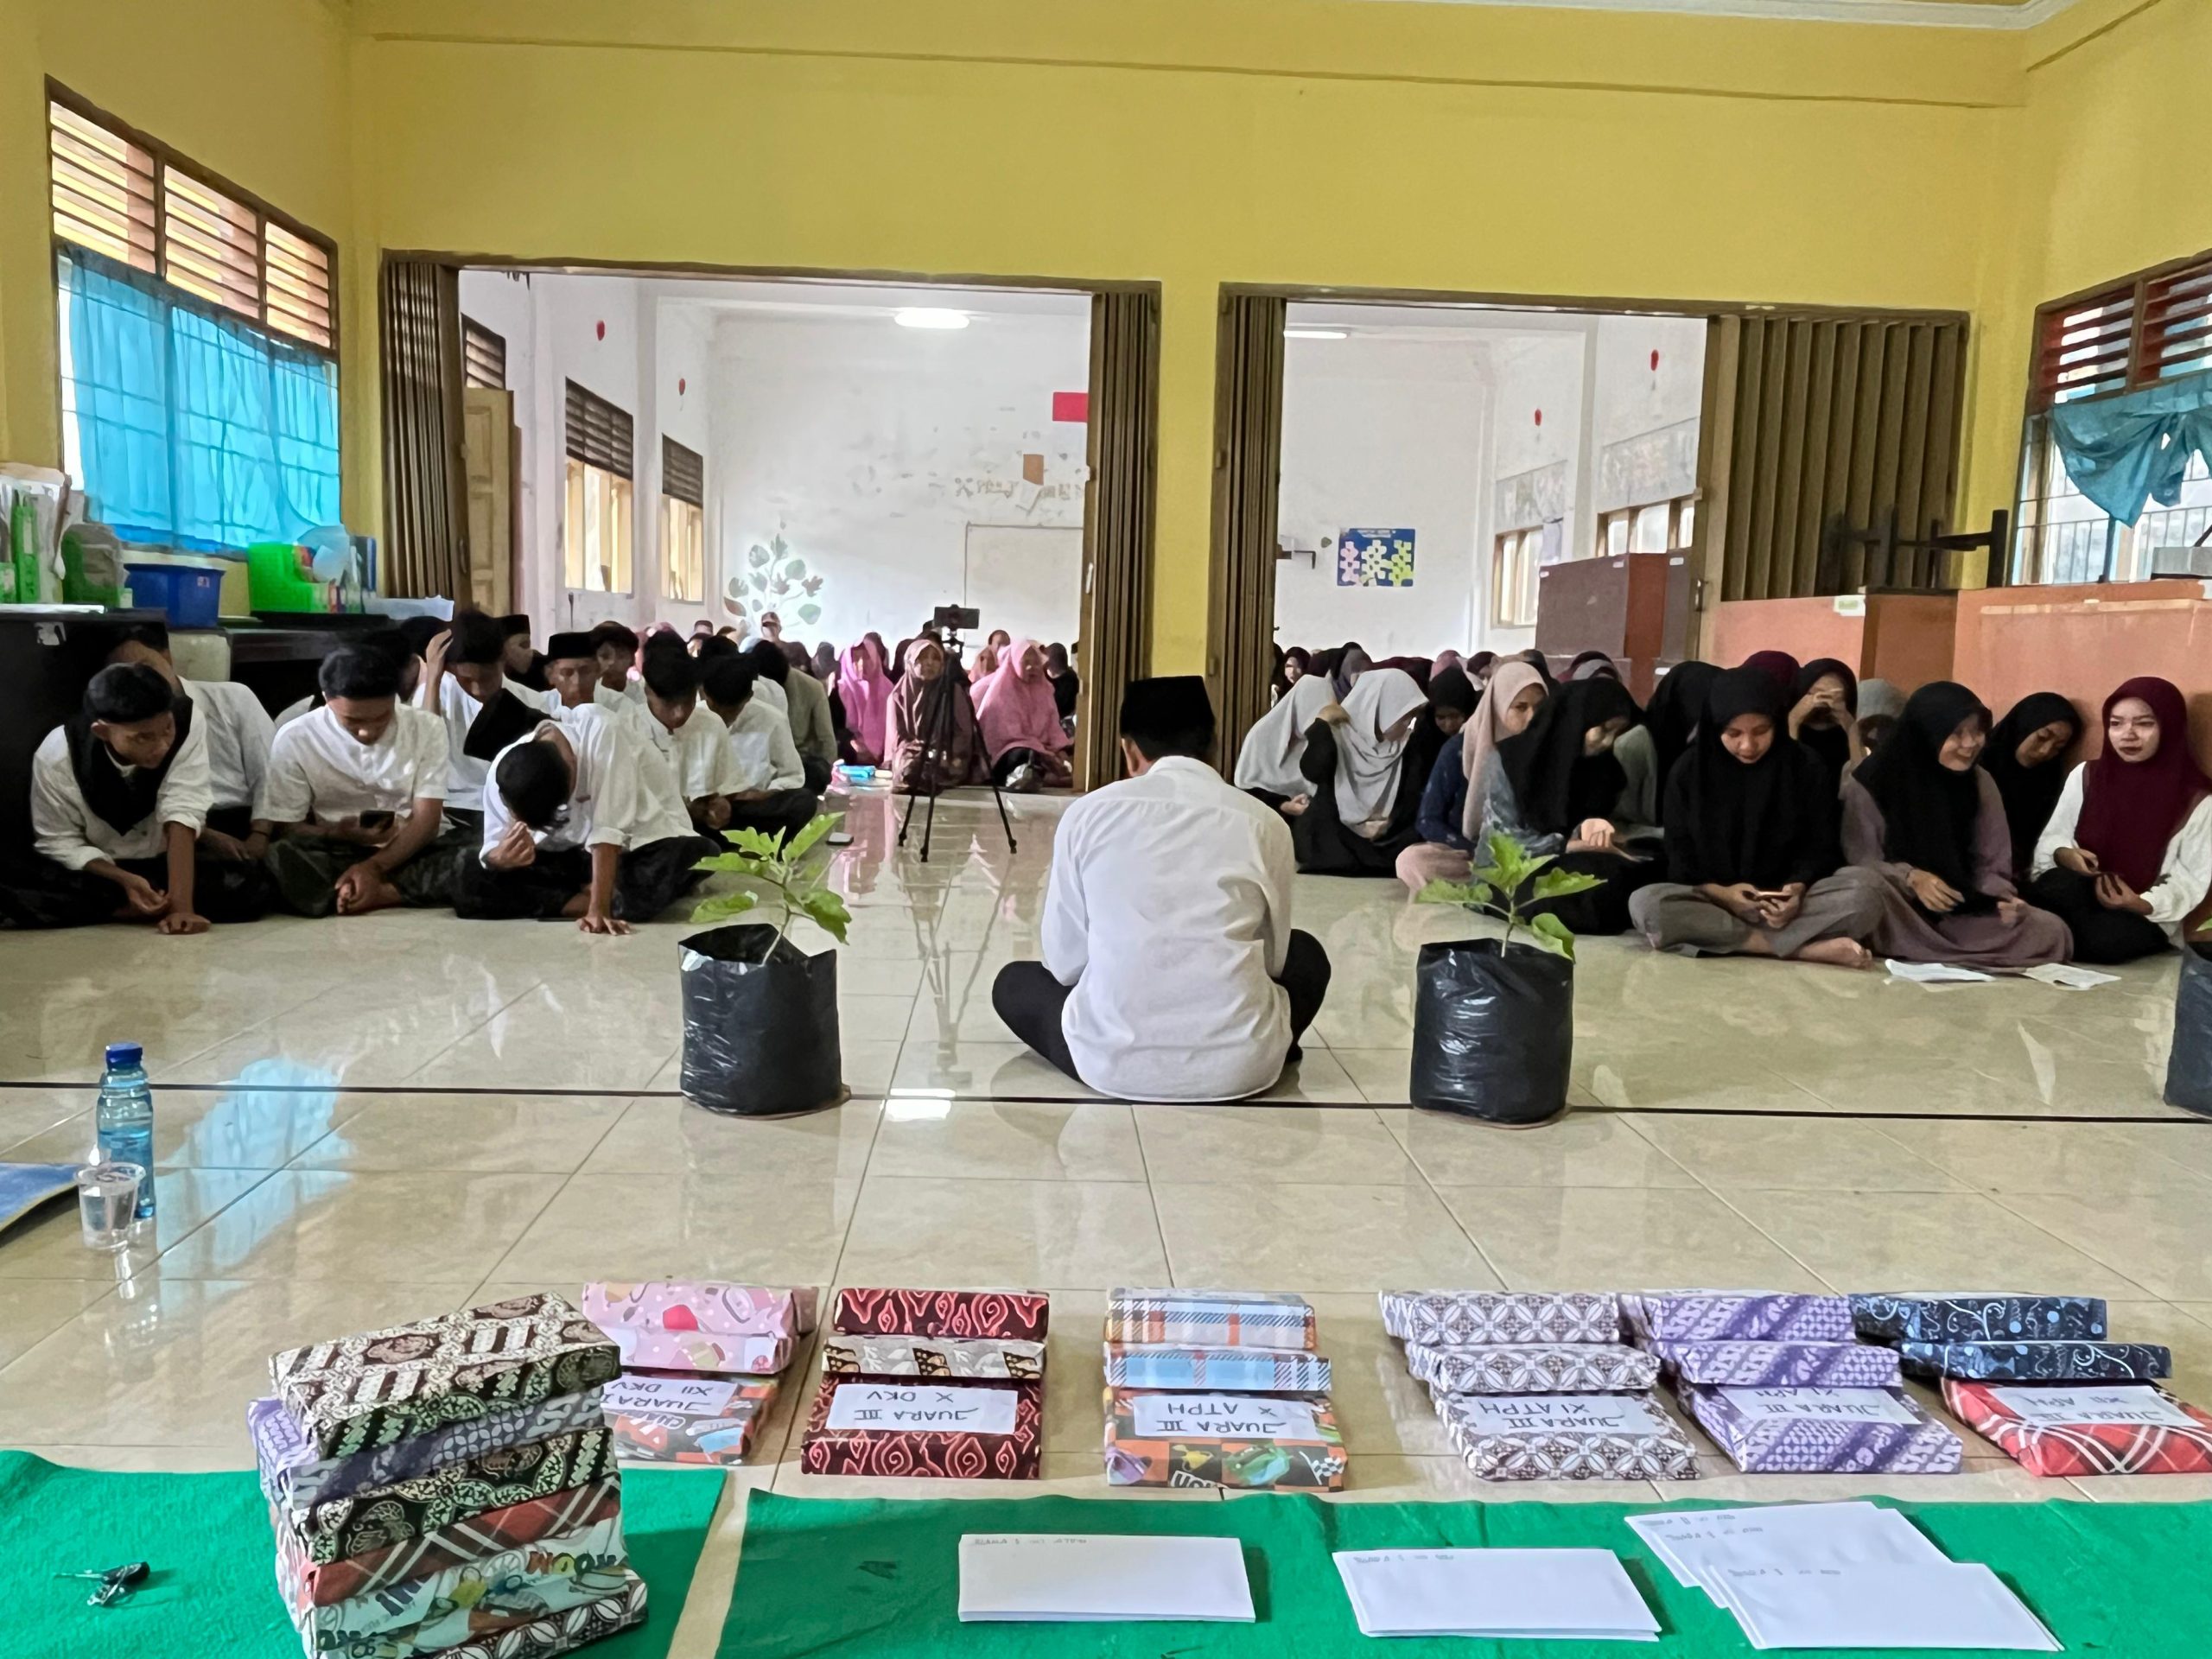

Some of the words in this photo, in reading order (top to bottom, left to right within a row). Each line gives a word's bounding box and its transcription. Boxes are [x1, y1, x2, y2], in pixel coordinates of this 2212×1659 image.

[611, 1381, 662, 1393] DKV
[681, 1386, 714, 1396] XII
[866, 1390, 917, 1402] DKV
[935, 1392, 954, 1403] X
[617, 1395, 712, 1411] JUARA
[1167, 1402, 1238, 1415] ATPH
[1478, 1401, 1551, 1415] ATPH
[1560, 1403, 1591, 1414] XI
[854, 1408, 883, 1421] III
[893, 1408, 979, 1421] JUARA
[1258, 1407, 1277, 1417] X
[1794, 1403, 1880, 1417] JUARA
[2076, 1410, 2164, 1423] JUARA
[1155, 1420, 1188, 1432] III
[1197, 1421, 1287, 1434] JUARA
[1503, 1417, 1537, 1429] III
[1540, 1414, 1625, 1428] JUARA
